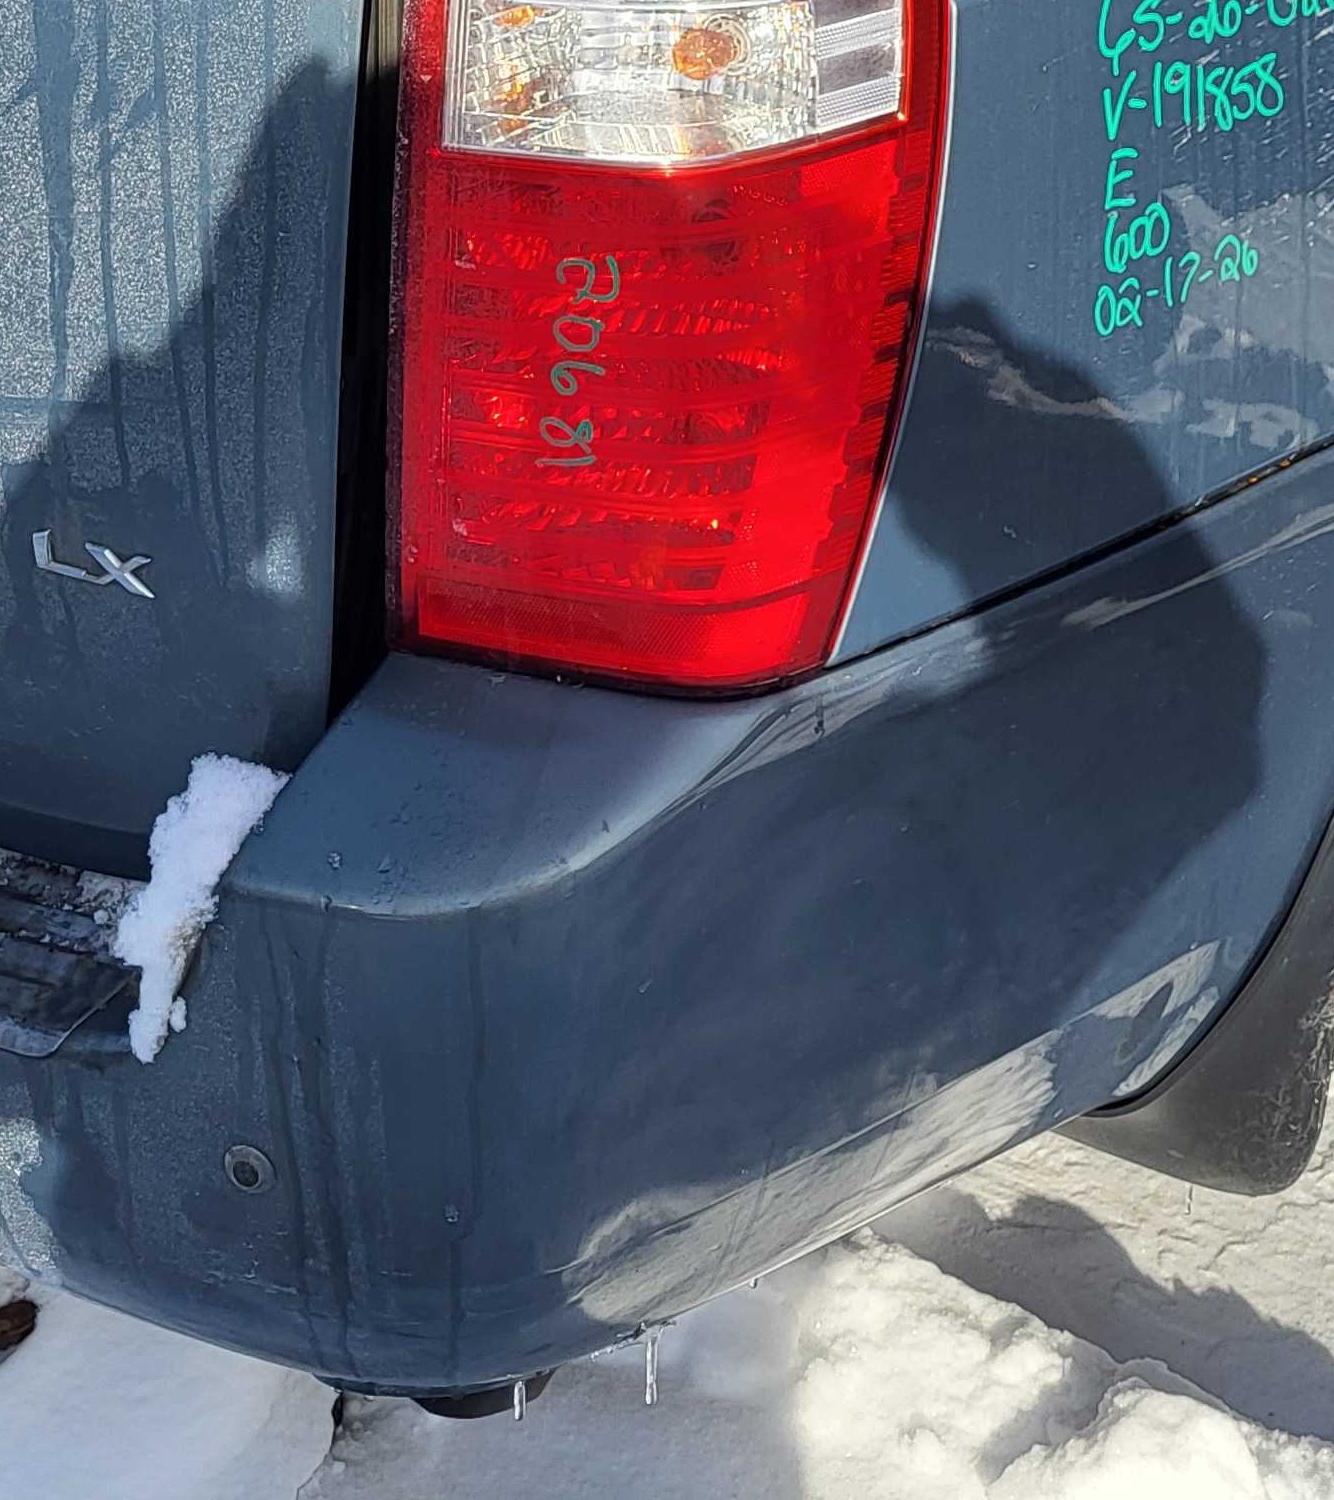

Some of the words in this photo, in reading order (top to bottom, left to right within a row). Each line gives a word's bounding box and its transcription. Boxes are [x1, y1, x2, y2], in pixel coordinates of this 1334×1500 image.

[1104, 147, 1139, 211] E
[1104, 201, 1171, 274] 600
[1094, 234, 1259, 337] 02-17-26
[535, 255, 620, 467] 20681
[32, 529, 155, 598] LX
